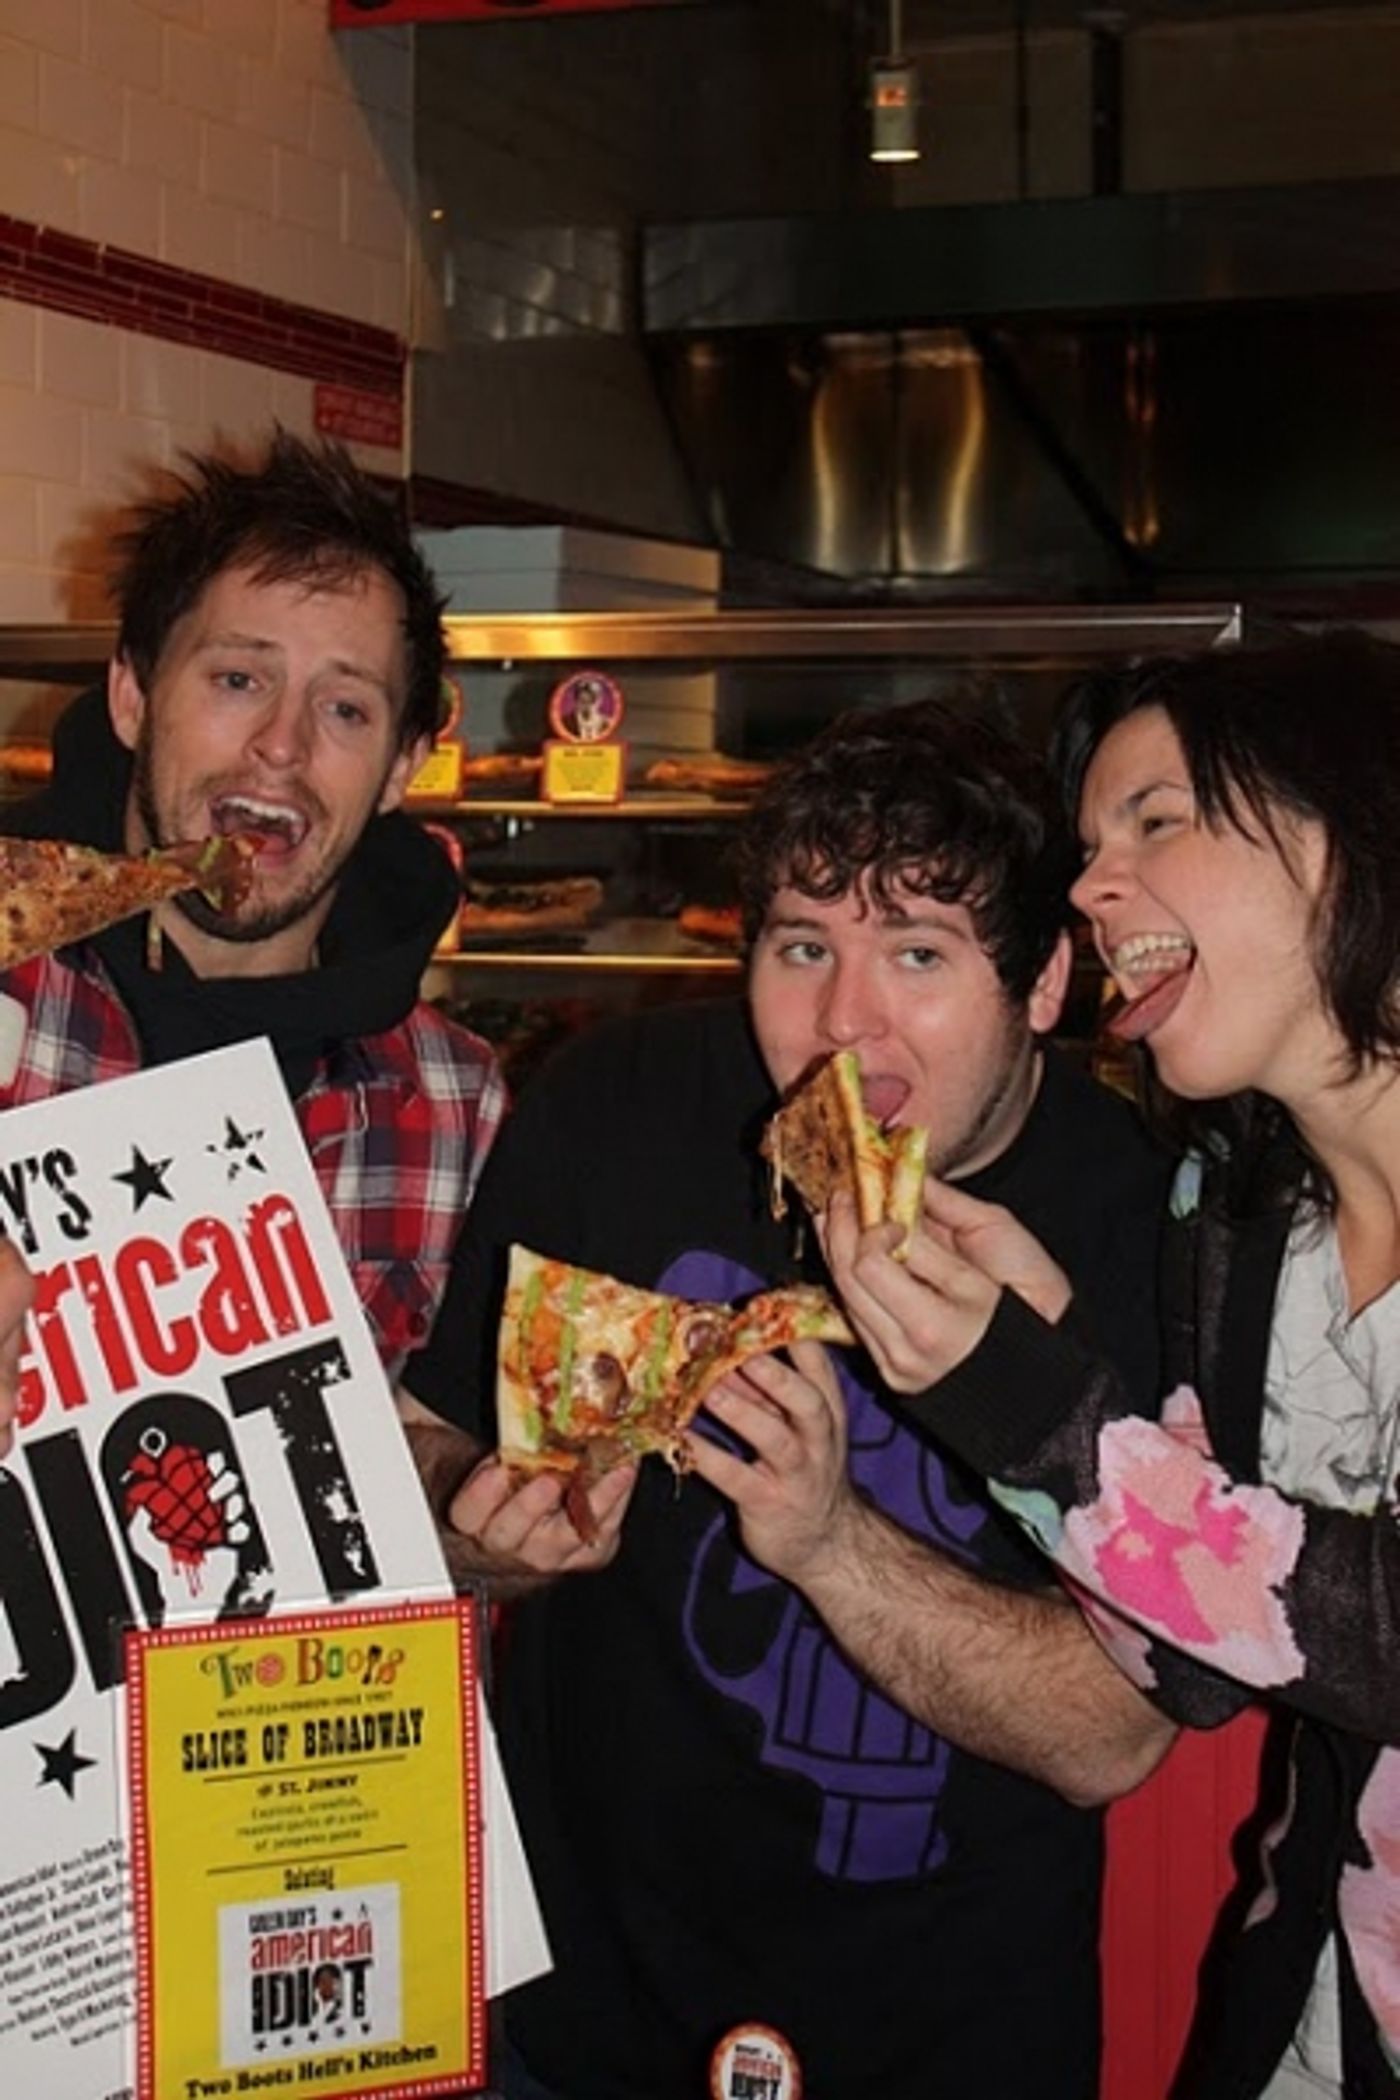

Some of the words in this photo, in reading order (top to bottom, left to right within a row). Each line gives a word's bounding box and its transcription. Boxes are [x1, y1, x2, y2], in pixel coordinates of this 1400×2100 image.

[0, 1148, 92, 1253] Y'S
[182, 1729, 247, 1773] SLICE
[262, 1722, 289, 1763] OF
[304, 1708, 425, 1758] BROADWAY
[251, 1920, 373, 1971] american
[251, 1957, 374, 2034] IDIOT
[185, 2079, 232, 2098] Two
[237, 2068, 293, 2091] Boots
[297, 2057, 354, 2081] Hell's
[359, 2045, 438, 2071] Kitchen
